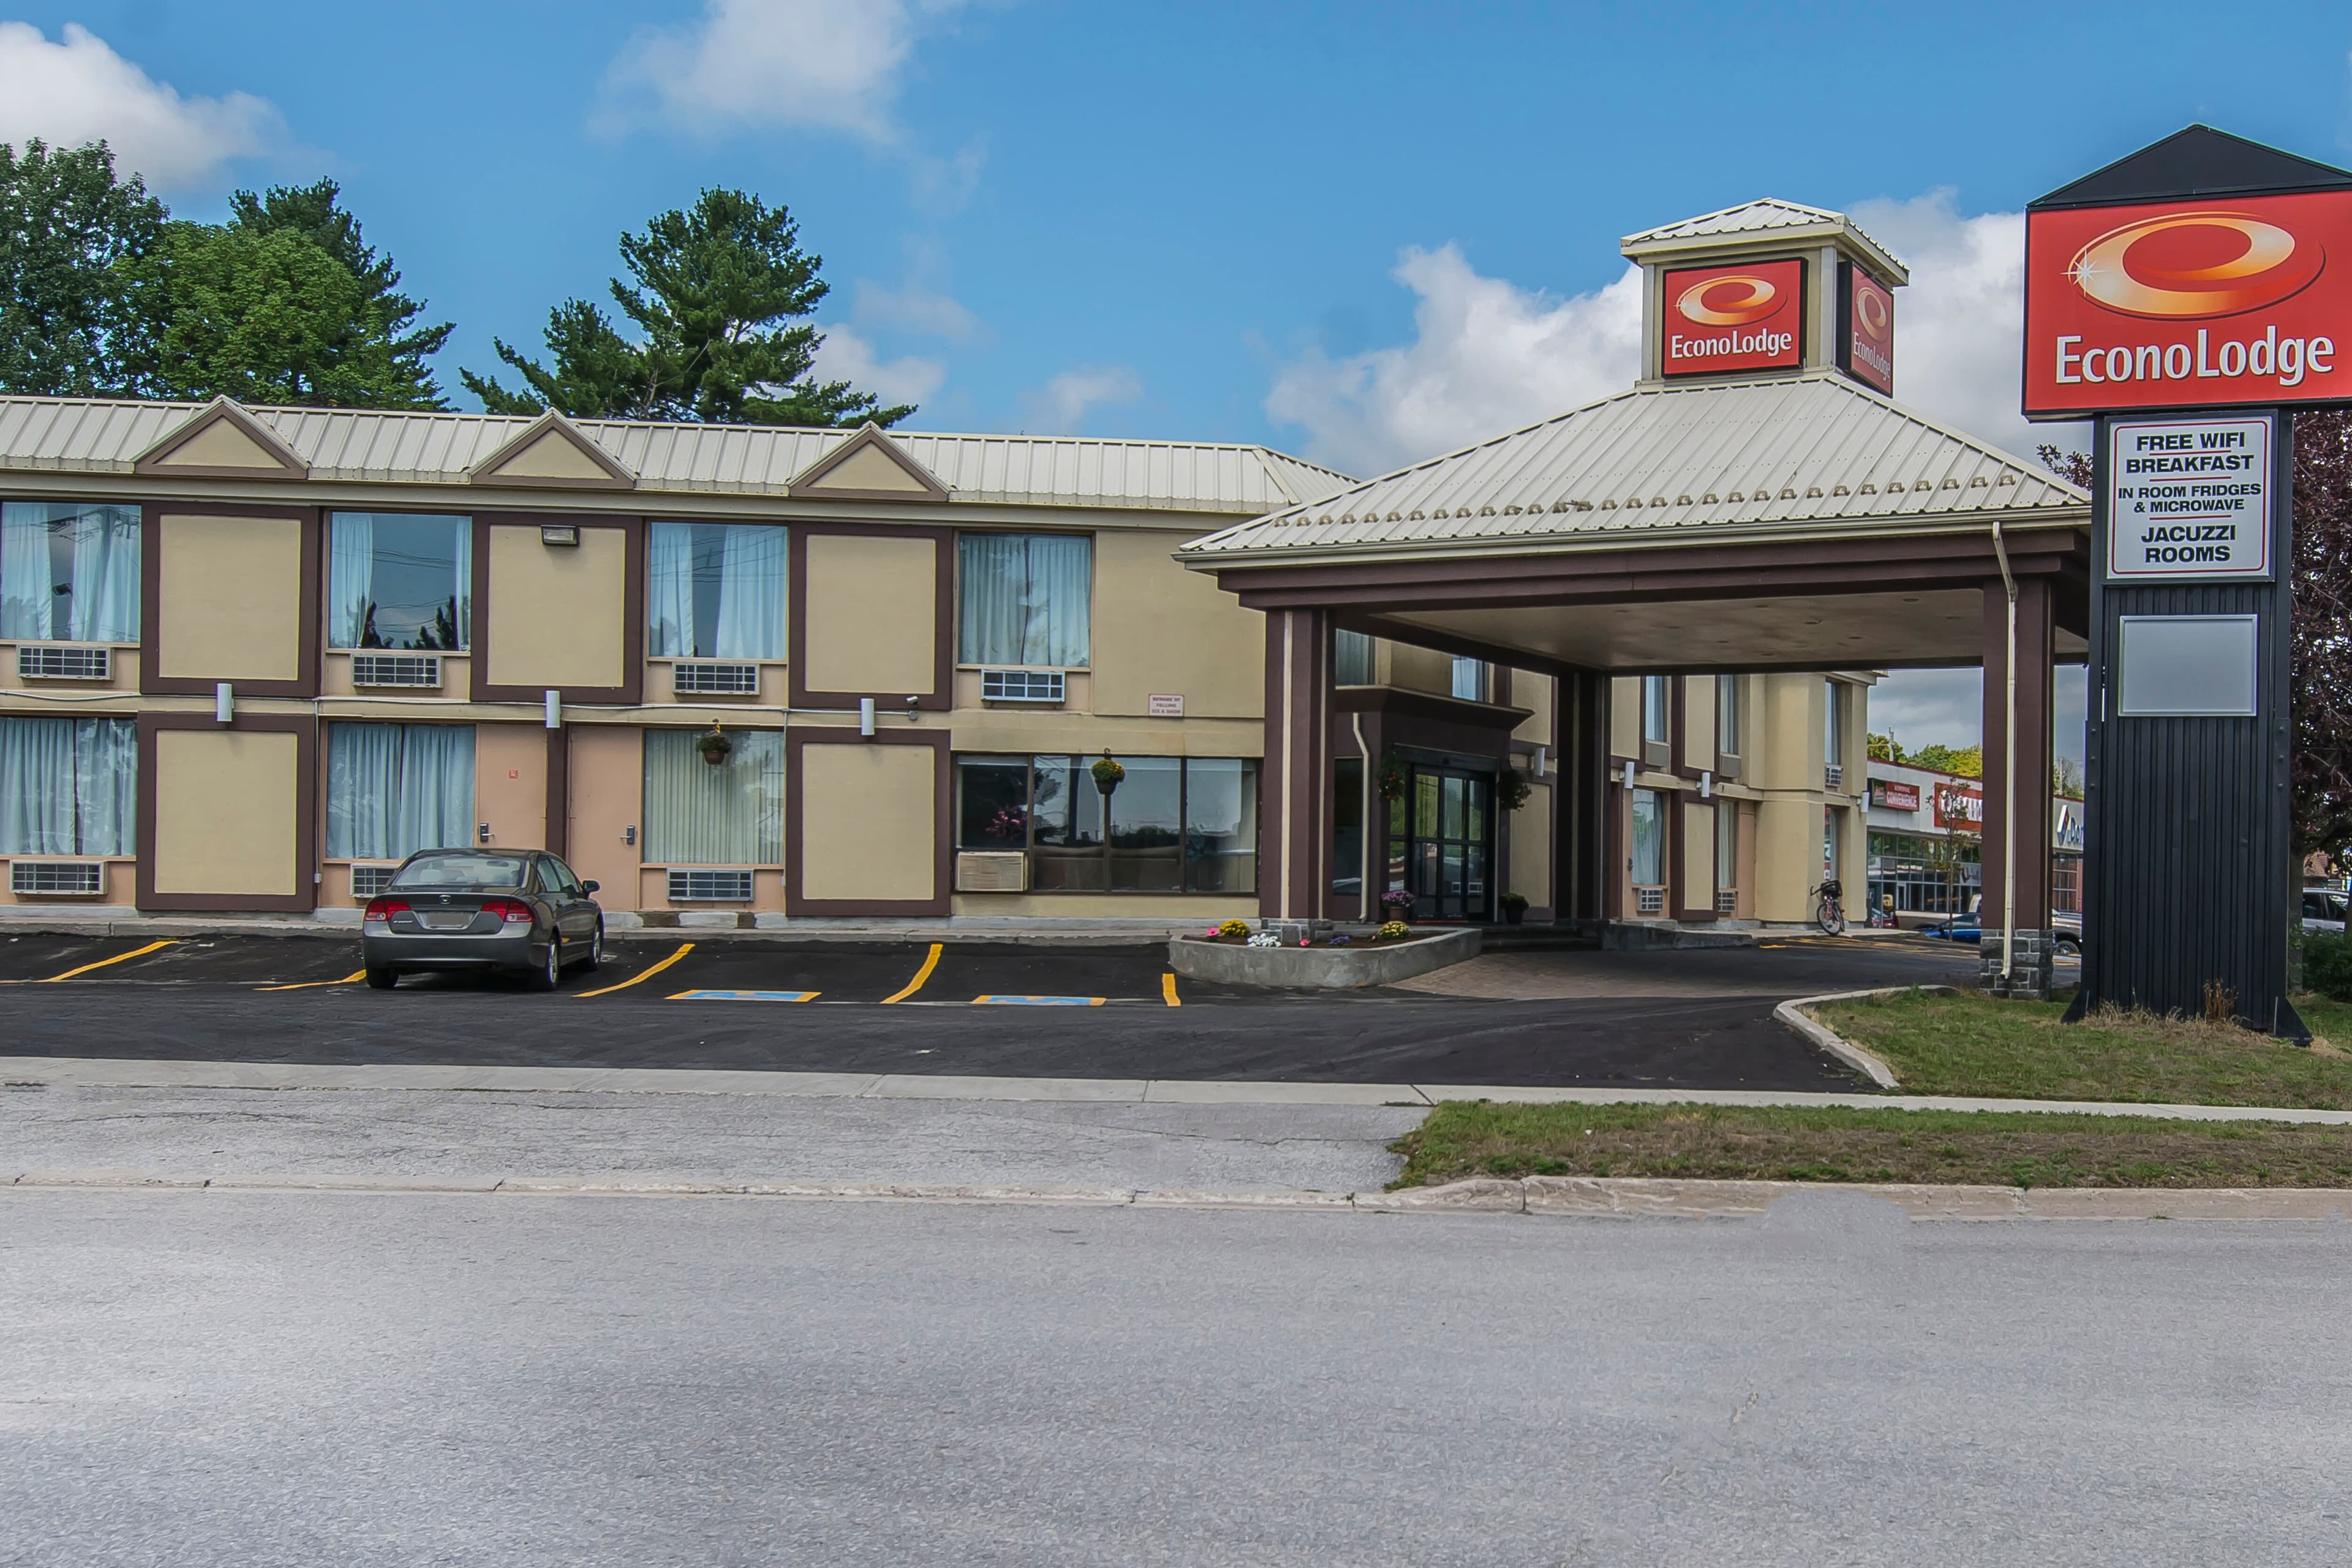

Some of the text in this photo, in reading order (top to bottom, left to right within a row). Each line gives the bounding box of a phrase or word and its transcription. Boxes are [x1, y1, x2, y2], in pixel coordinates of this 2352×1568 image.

[1671, 327, 1793, 358] EconoLodge
[1853, 331, 1891, 381] EconoLodge
[2056, 325, 2334, 386] EconoLodge
[2136, 431, 2245, 451] FREE WIFI
[2126, 454, 2255, 473] BREAKFAST
[2118, 483, 2262, 499] IN ROOM FRIDGES
[2133, 499, 2245, 513] & MICROWAVE
[2141, 524, 2236, 543] JACUZZI
[2145, 545, 2231, 564] ROOMS
